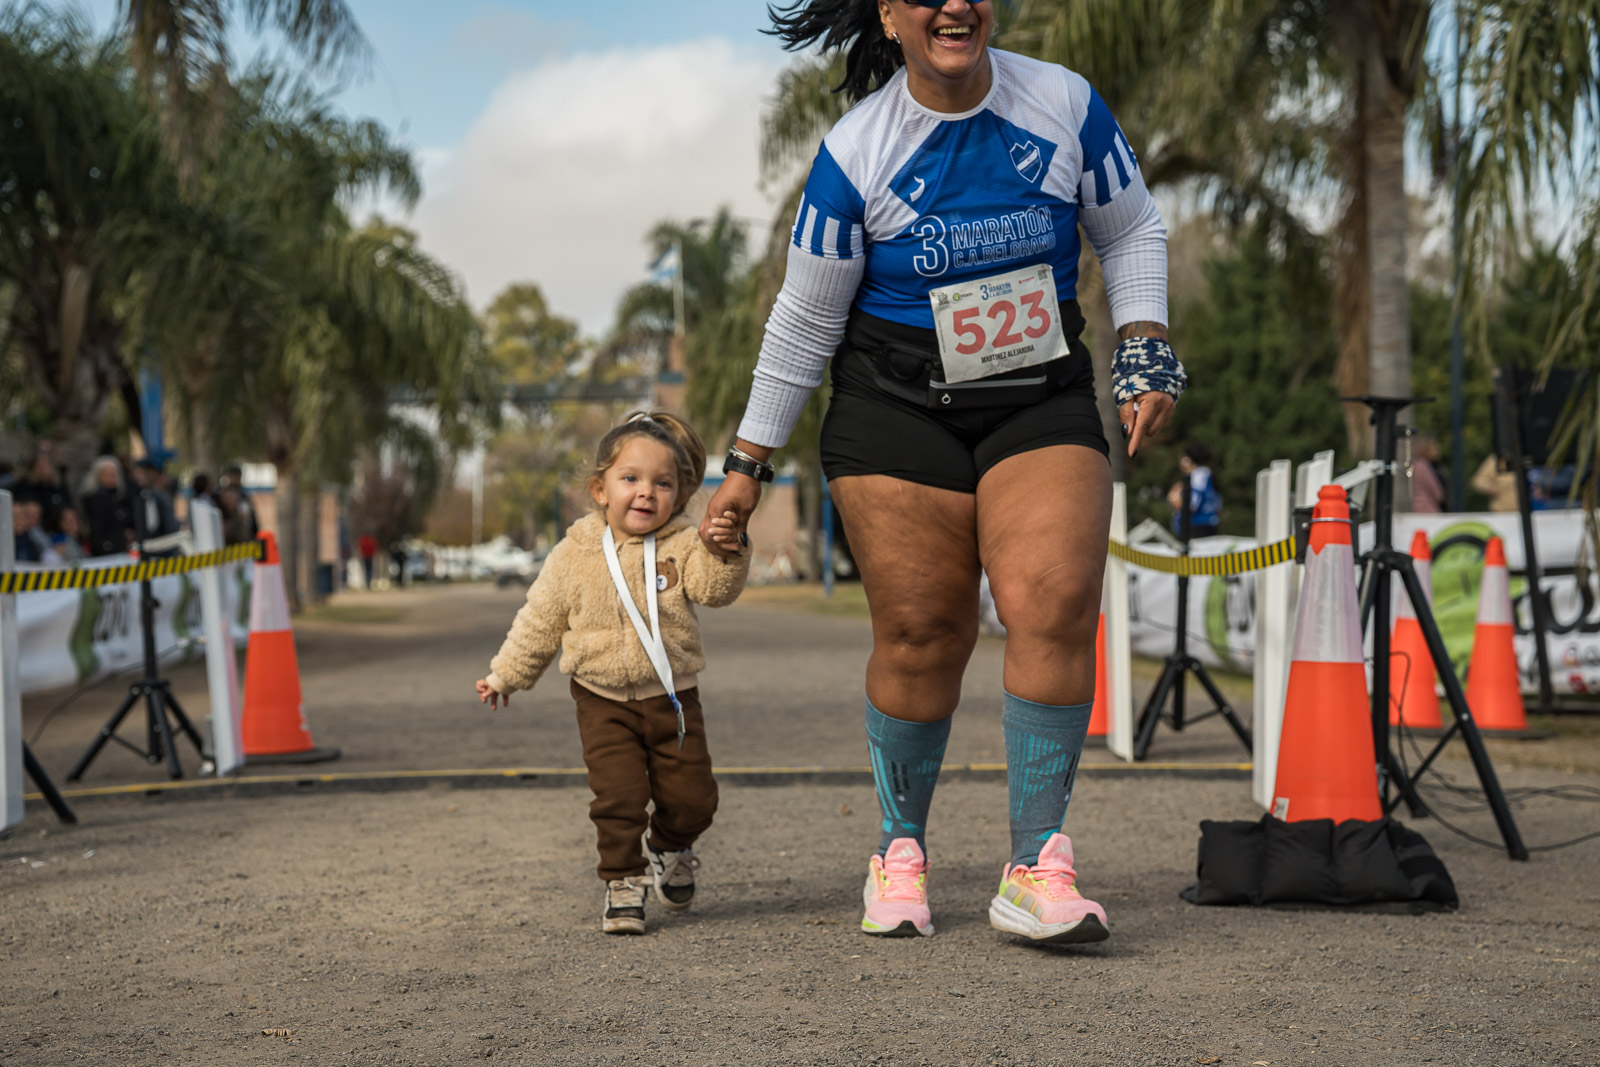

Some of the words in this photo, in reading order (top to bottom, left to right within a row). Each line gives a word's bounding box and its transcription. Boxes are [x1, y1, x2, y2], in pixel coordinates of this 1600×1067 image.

[911, 215, 949, 277] 3
[950, 205, 1053, 250] MARATÓN
[980, 284, 989, 300] 3
[953, 290, 1051, 355] 523
[981, 351, 1007, 364] MARTINEZ
[1007, 344, 1035, 357] ALEJANDRA
